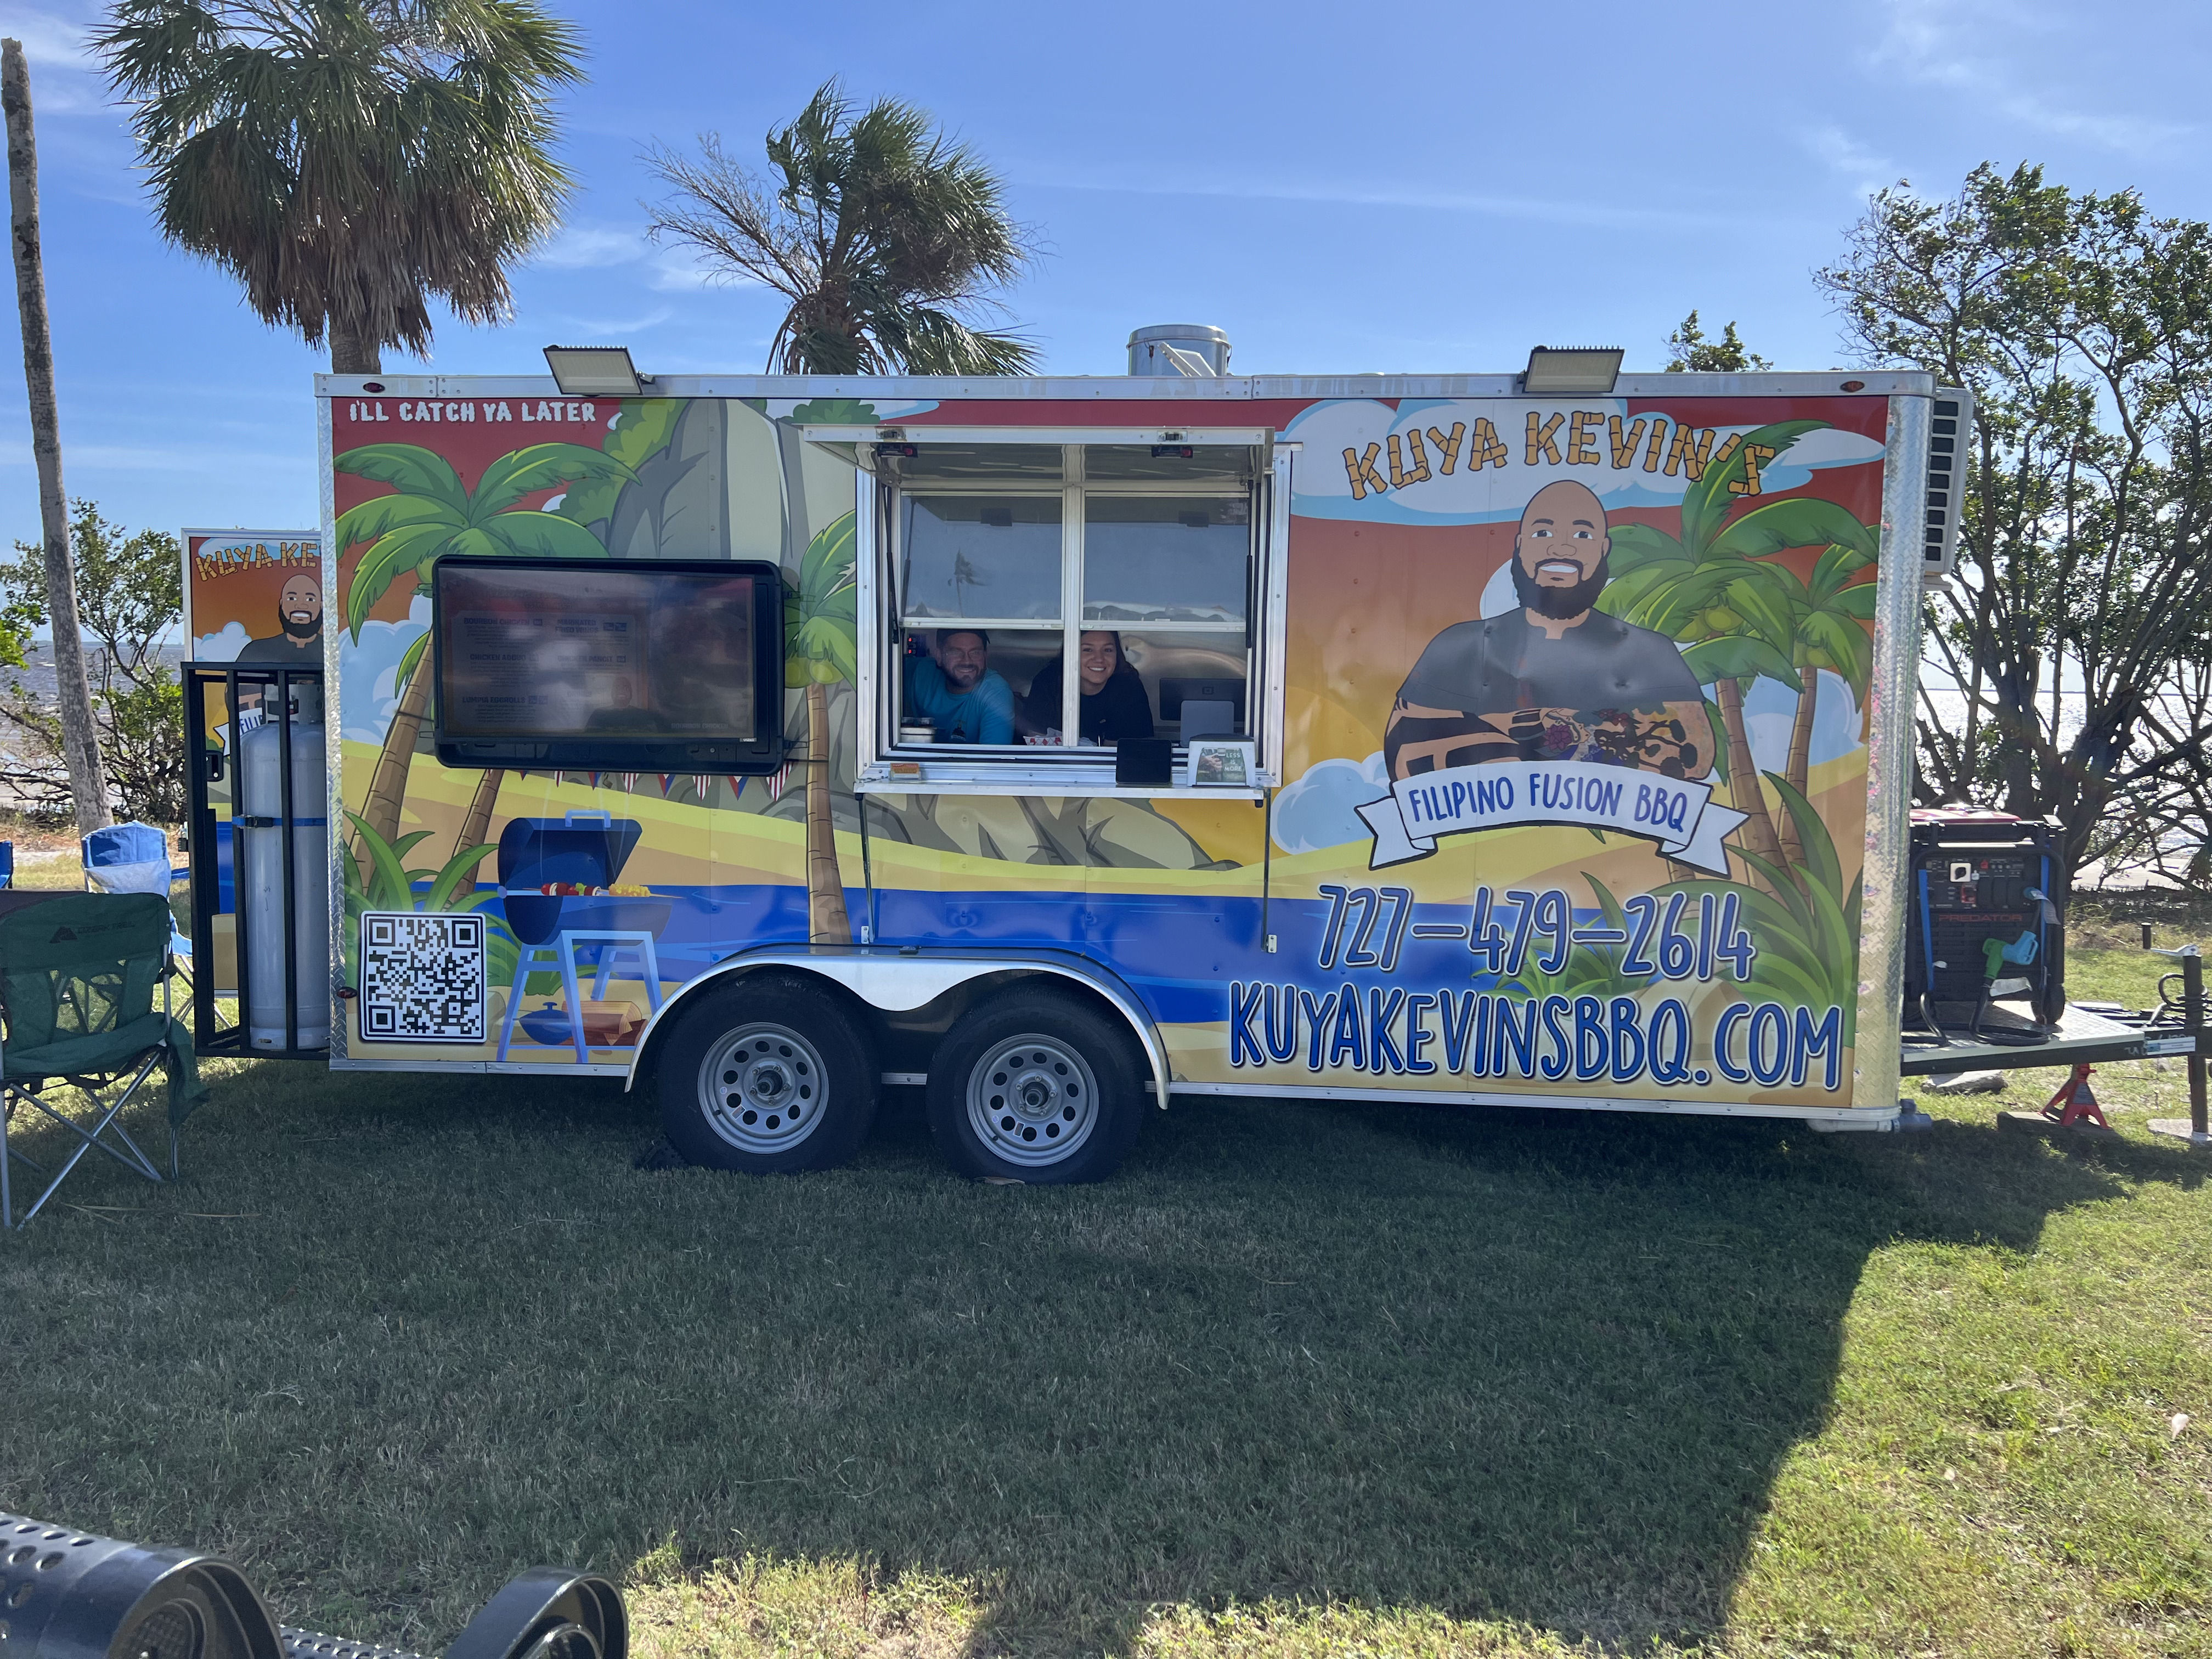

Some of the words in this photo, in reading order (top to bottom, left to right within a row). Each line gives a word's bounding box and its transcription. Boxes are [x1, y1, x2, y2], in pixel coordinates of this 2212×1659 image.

[349, 400, 389, 421] I'LL
[399, 401, 475, 422] CATCH
[483, 402, 512, 422] YA
[522, 401, 596, 422] LATER
[1342, 417, 1508, 500] KUYA
[195, 544, 273, 581] KUYA
[280, 542, 321, 568] KE
[1408, 776, 1514, 822] FILIPINO
[1530, 773, 1623, 817] FUSION
[1633, 784, 1688, 832] BBQ
[1939, 913, 2023, 922] PREDATOR
[1228, 980, 1843, 1091] KUYAKEVINSBBQ.COM
